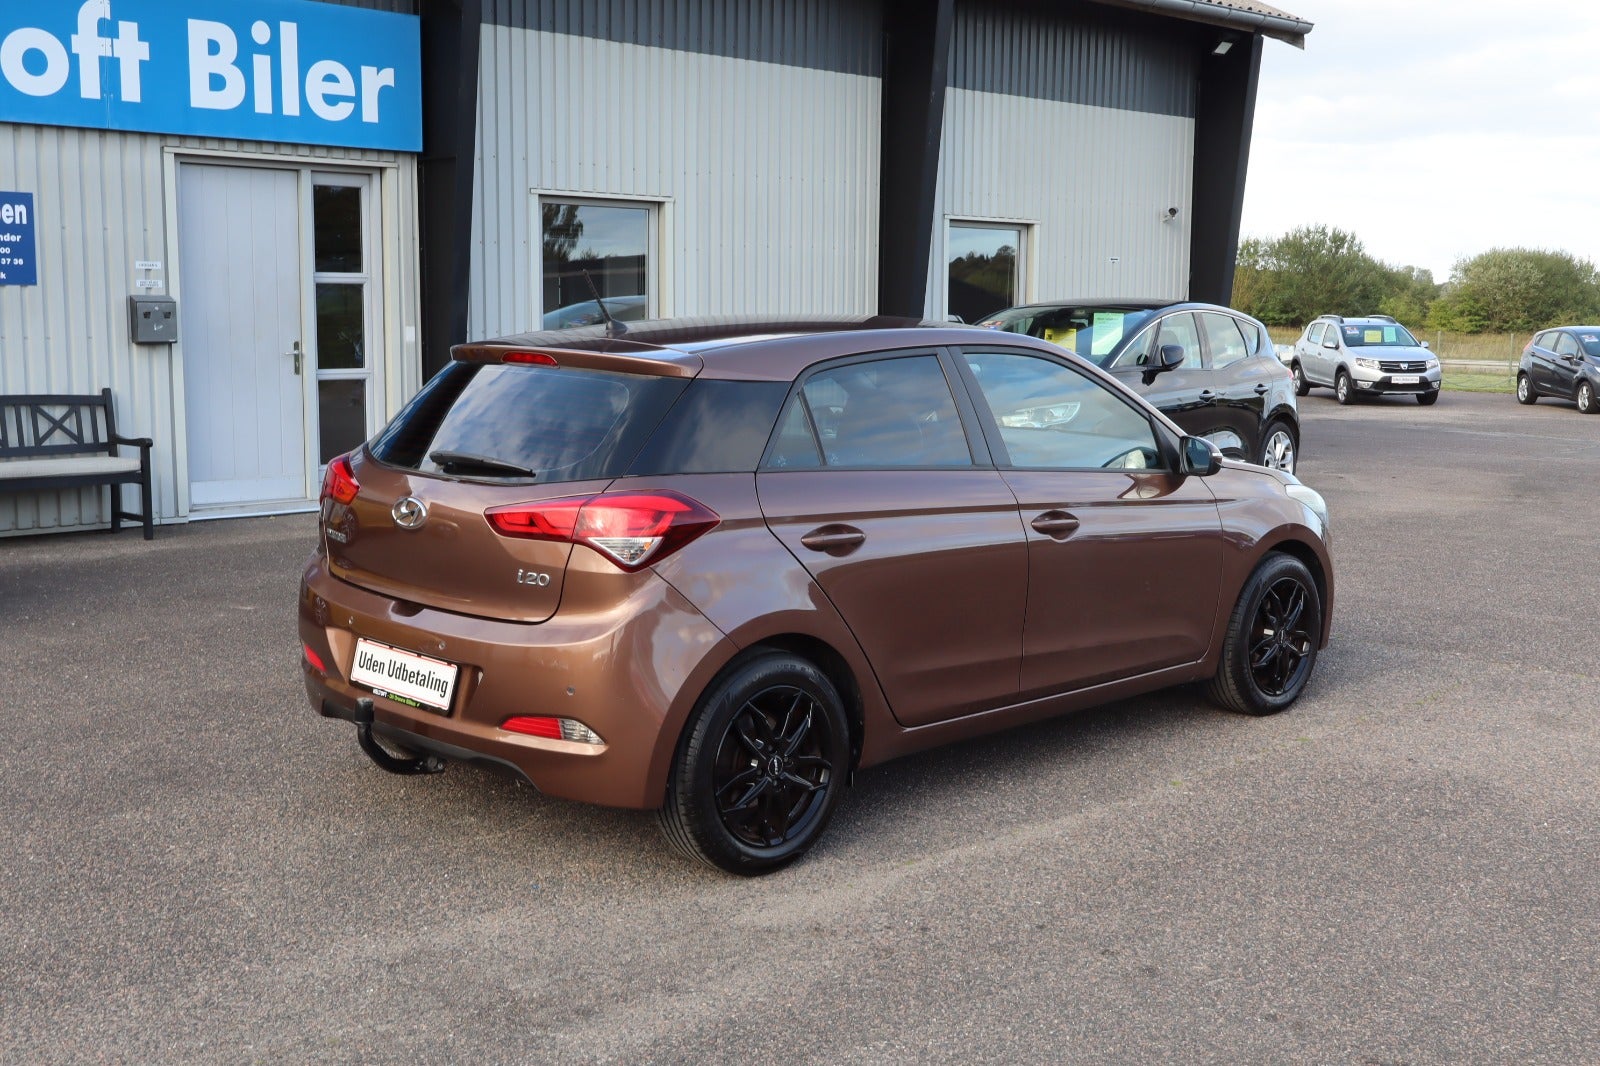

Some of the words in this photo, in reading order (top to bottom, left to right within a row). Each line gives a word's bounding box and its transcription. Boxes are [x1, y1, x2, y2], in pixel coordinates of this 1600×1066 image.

[0, 0, 150, 103] oft
[187, 18, 394, 123] Biler
[0, 203, 27, 225] en
[517, 568, 550, 586] i20
[358, 650, 386, 675] Uden
[387, 659, 449, 698] Udbetaling
